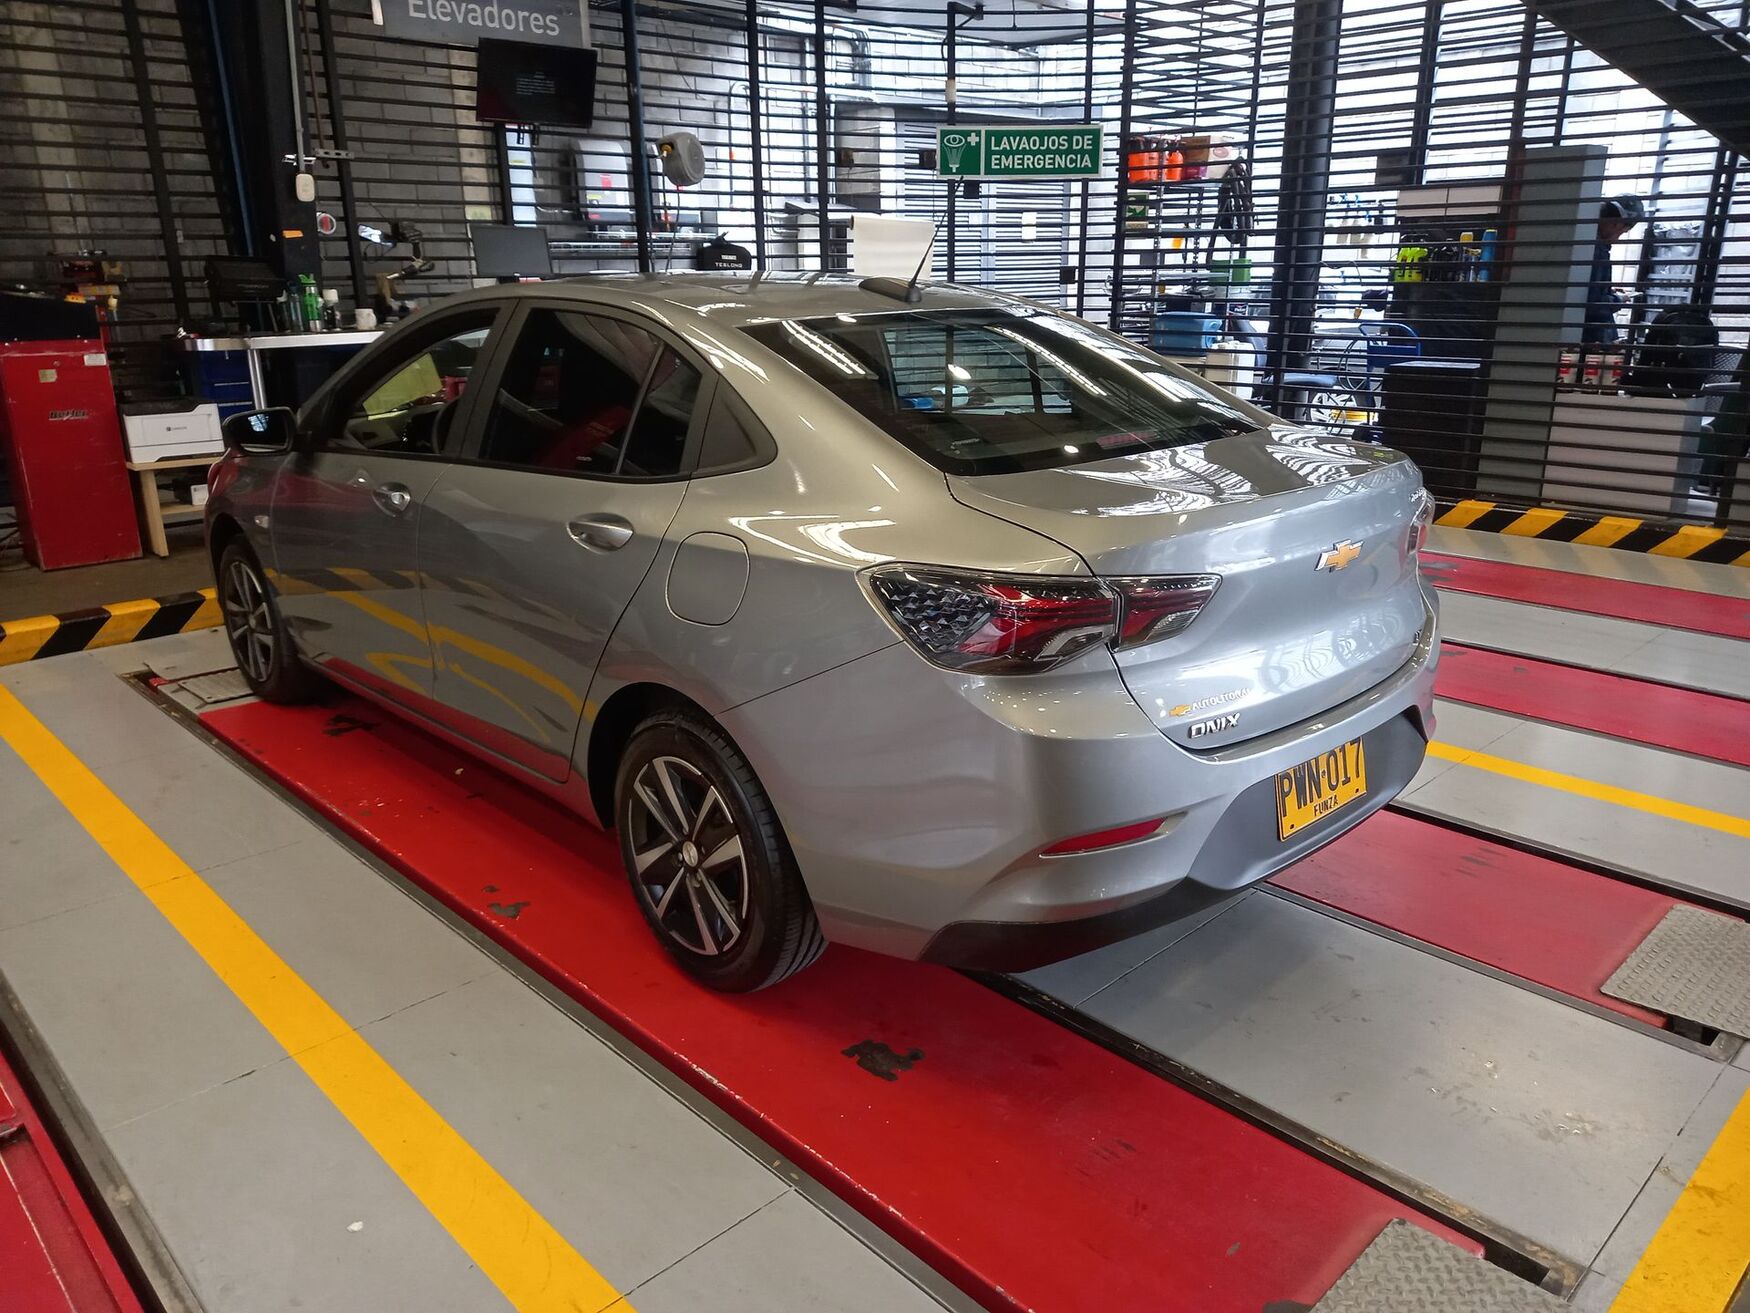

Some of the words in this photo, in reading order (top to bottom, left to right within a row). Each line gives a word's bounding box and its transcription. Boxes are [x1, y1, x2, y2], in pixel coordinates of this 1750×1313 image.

[408, 0, 560, 36] Elevadores
[991, 135, 1068, 150] LAVAOJOS
[1072, 135, 1093, 149] DE
[991, 154, 1092, 169] EMERGENCIA
[1188, 712, 1240, 739] ONIX
[1314, 795, 1338, 816] FUNZA
